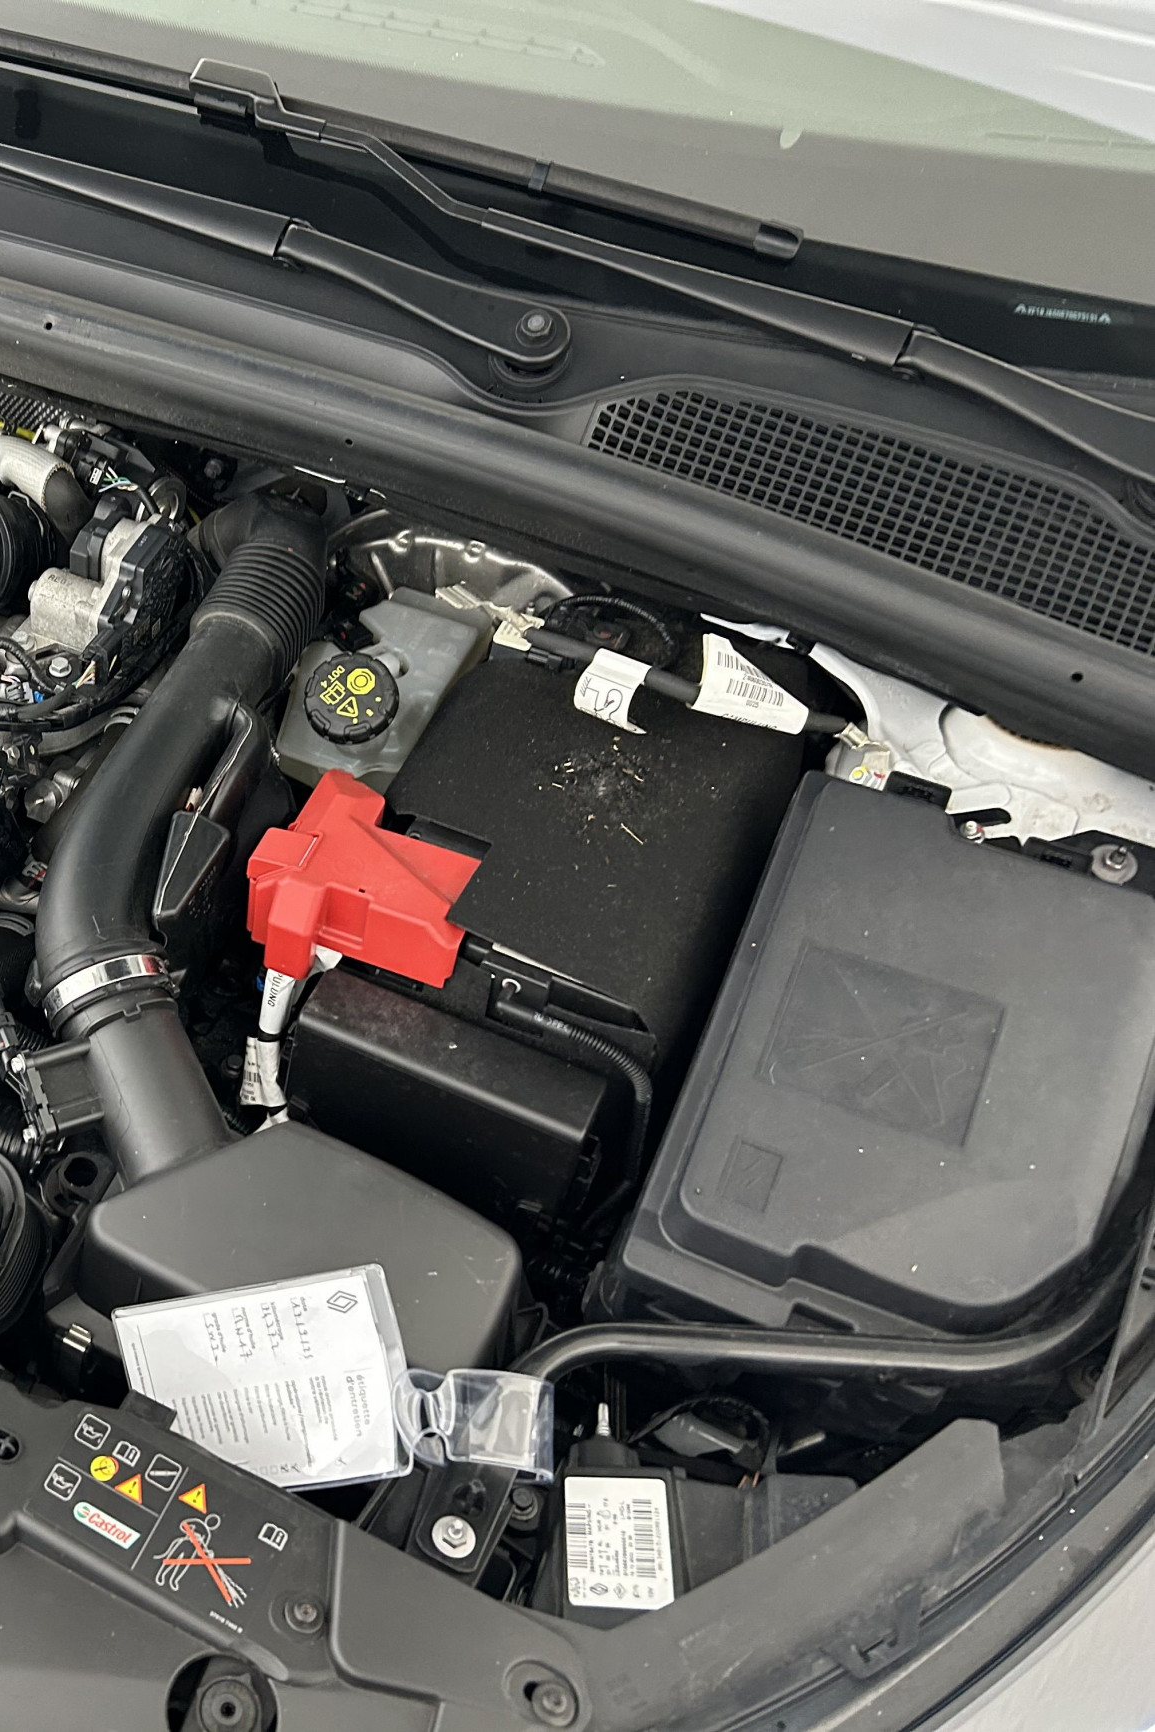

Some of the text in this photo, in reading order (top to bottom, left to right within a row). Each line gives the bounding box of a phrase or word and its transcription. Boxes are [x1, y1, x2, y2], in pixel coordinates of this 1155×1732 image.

[320, 665, 346, 689] DOT 4
[346, 1375, 364, 1438] d'entretien
[357, 1374, 372, 1426] étiquette
[88, 1512, 134, 1545] Castrol
